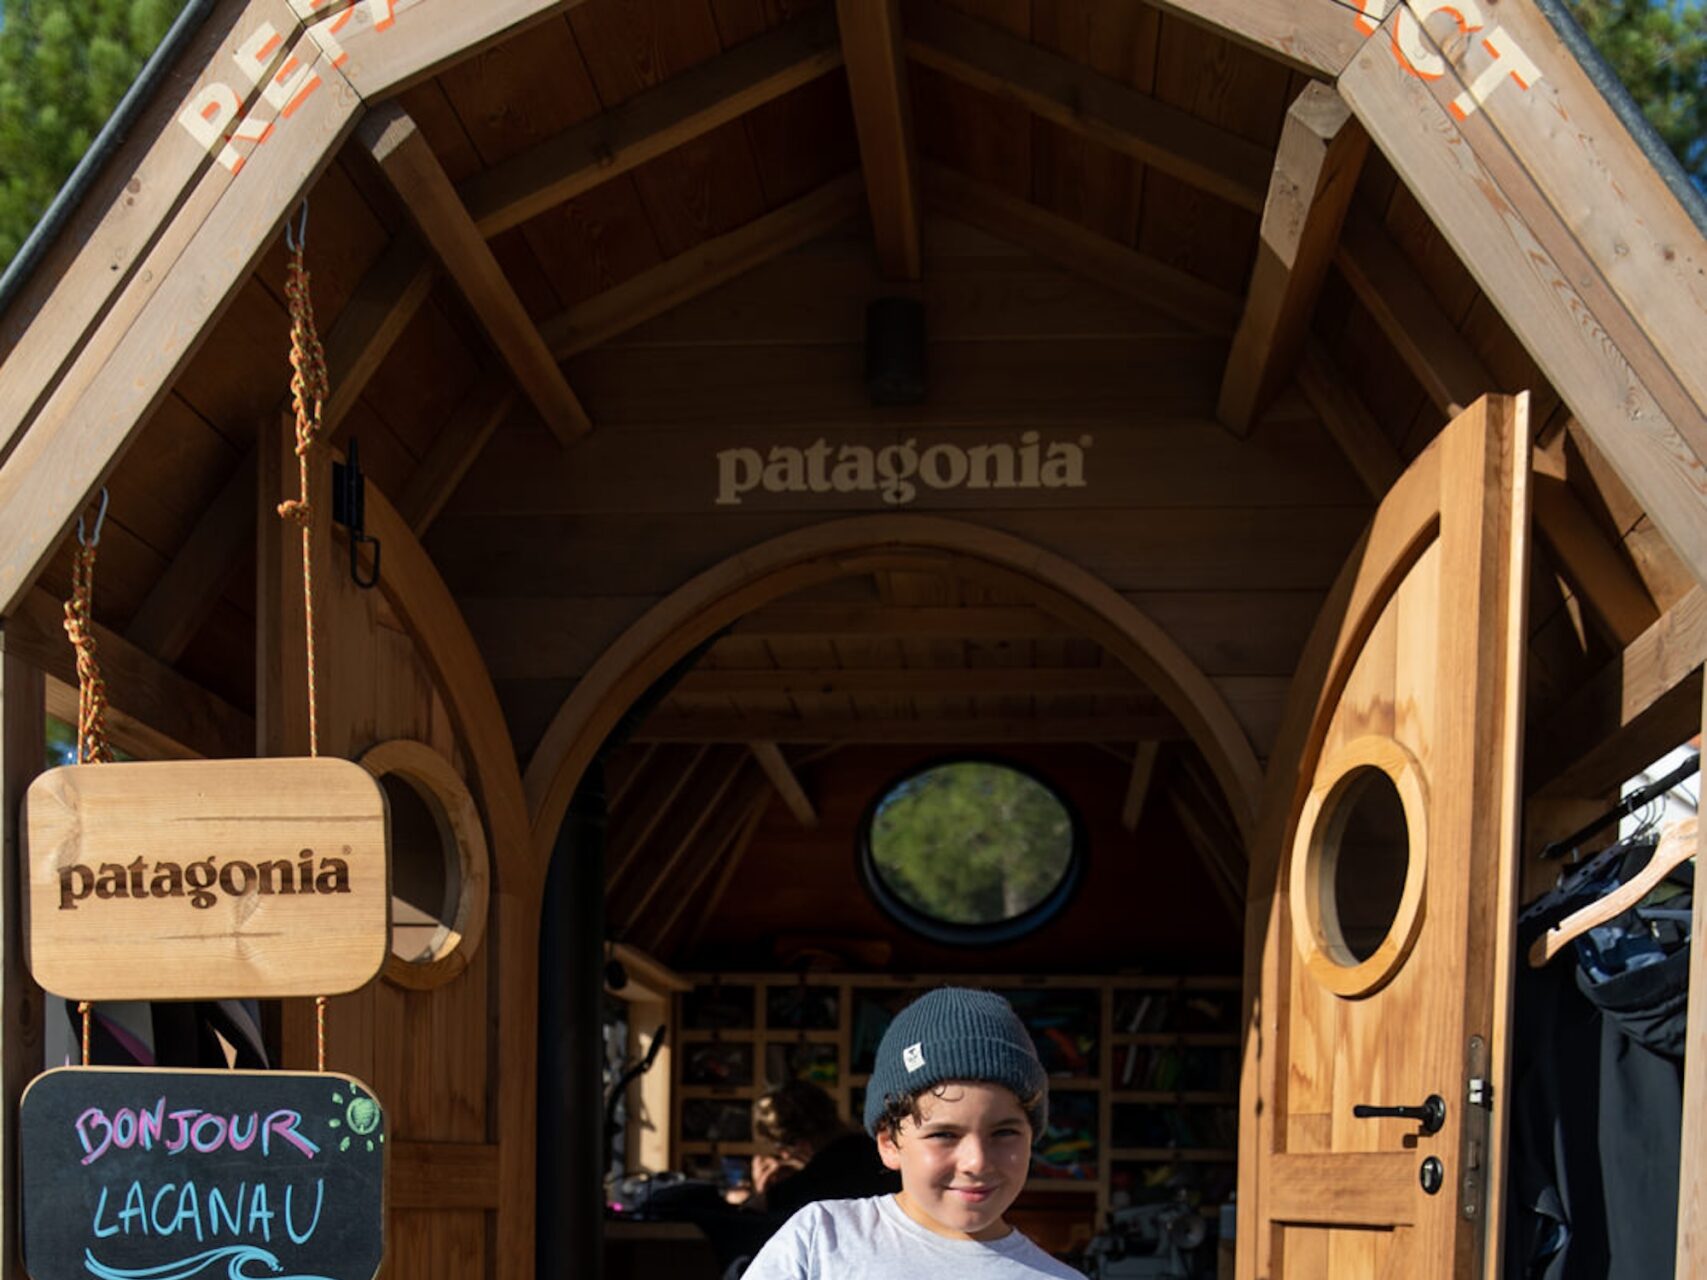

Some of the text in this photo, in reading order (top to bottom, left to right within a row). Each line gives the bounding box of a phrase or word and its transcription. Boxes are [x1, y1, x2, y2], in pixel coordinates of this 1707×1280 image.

[715, 430, 1089, 504] patagonia
[58, 849, 351, 910] patagonia
[76, 1096, 320, 1165] BONJOUR
[94, 1178, 324, 1246] LACANAU
